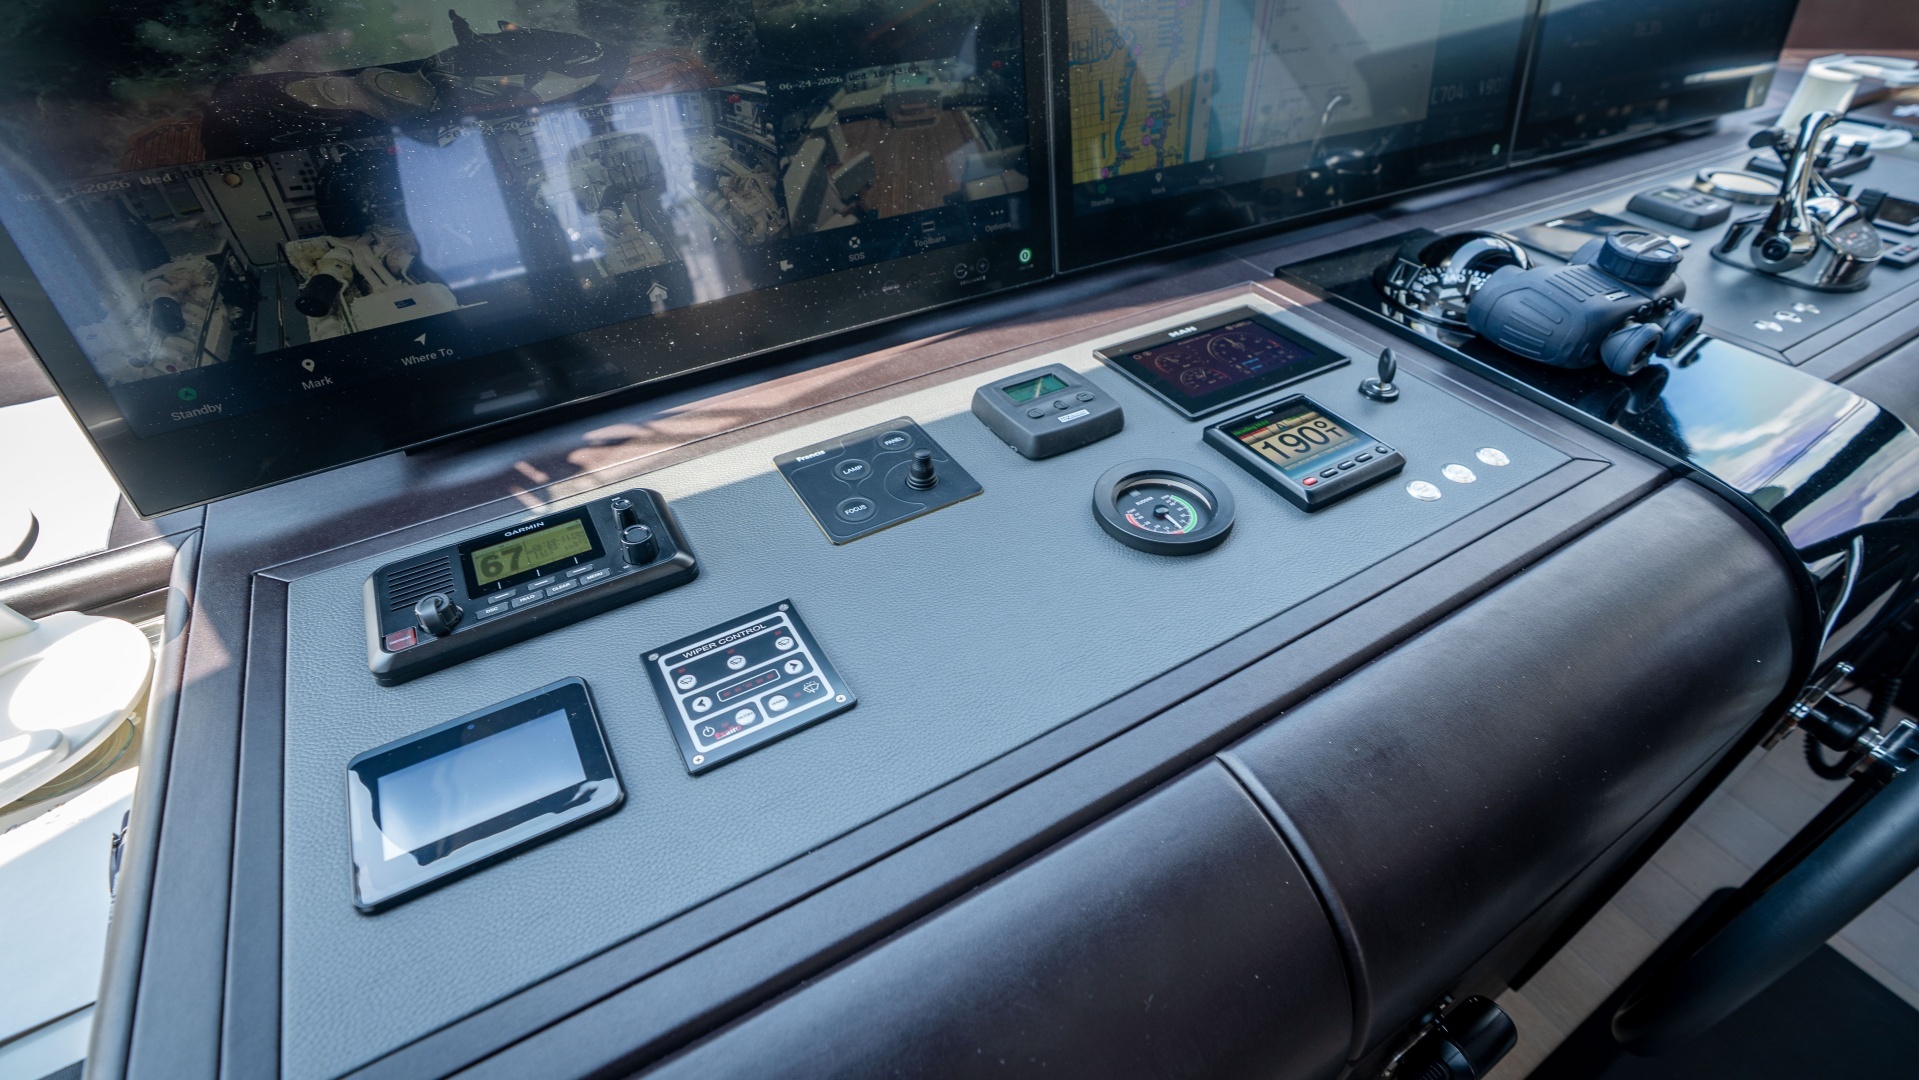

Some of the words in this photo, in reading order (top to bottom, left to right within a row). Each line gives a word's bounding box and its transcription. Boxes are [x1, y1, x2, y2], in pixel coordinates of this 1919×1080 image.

[984, 220, 1012, 233] Options
[913, 235, 947, 249] Toolbars
[848, 252, 866, 262] SOS
[401, 351, 438, 367] Where
[438, 348, 454, 358] To
[302, 375, 334, 391] Mark
[171, 402, 223, 422] Standby
[884, 436, 905, 446] PANEL
[795, 450, 826, 462] Francis
[842, 465, 863, 475] LAMP
[845, 504, 868, 516] FOCUS
[504, 521, 545, 538] GARMIN
[480, 545, 523, 579] 67
[586, 571, 603, 580] MENU
[551, 582, 571, 592] CLEAR
[485, 606, 499, 614] DSC
[682, 642, 718, 659] WIPER
[718, 624, 767, 645] CONTROL
